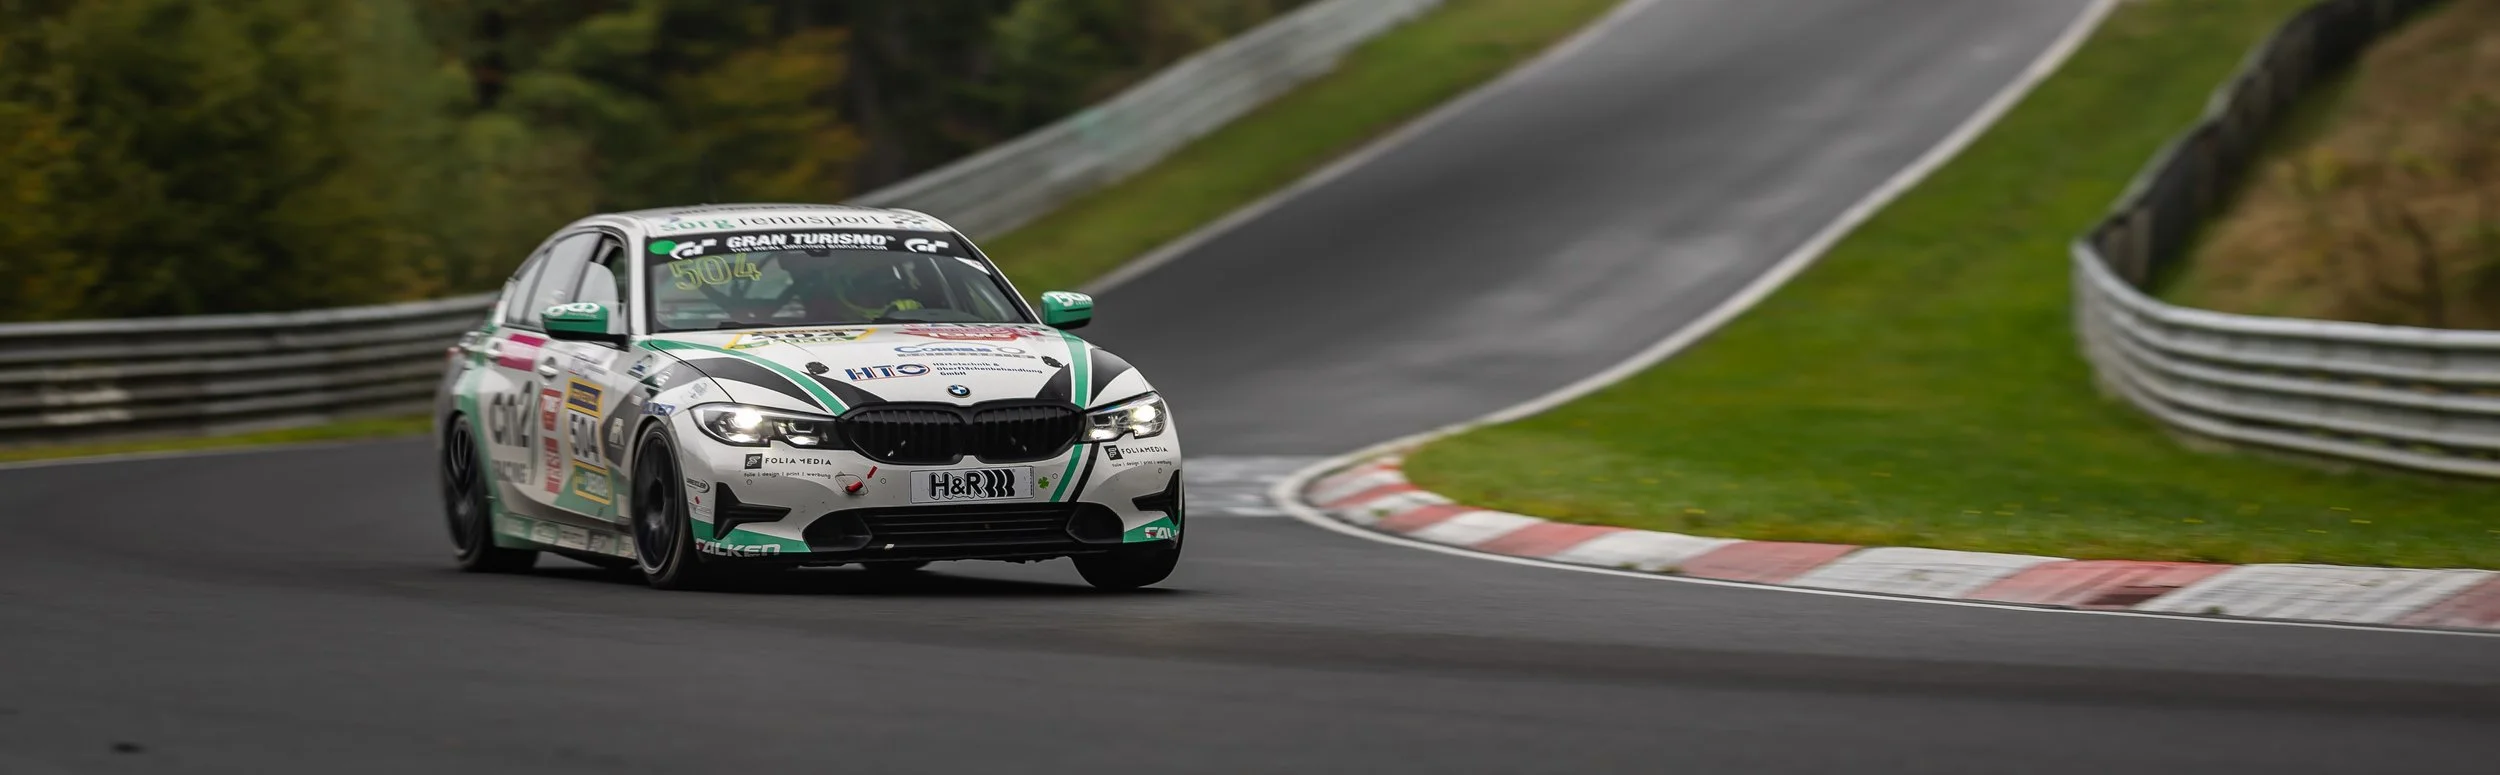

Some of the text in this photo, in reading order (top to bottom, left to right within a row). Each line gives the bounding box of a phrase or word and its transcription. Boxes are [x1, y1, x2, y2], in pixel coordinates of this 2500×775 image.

[726, 234, 787, 248] GRAN
[668, 253, 762, 290] 504
[569, 412, 600, 464] 504
[930, 472, 984, 497] H&R
[695, 538, 781, 558] FALKEN
